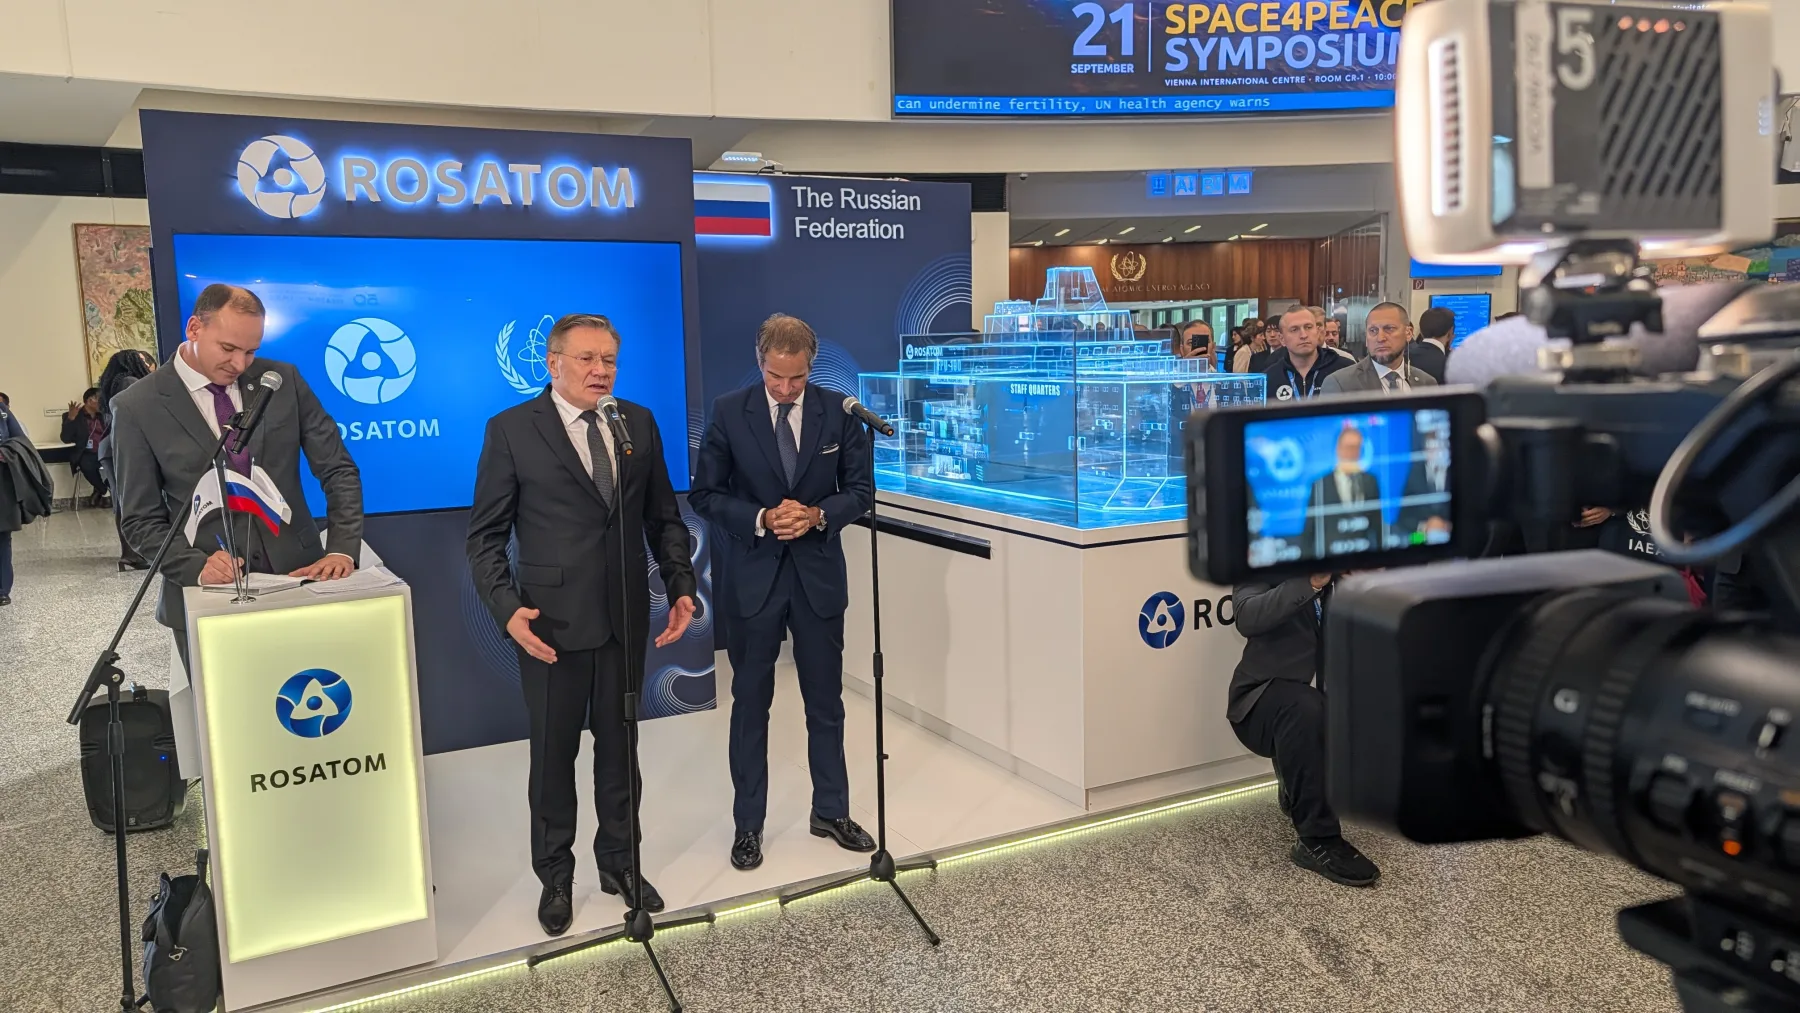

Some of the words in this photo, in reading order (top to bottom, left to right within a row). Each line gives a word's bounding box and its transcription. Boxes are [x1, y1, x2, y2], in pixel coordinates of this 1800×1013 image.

[1071, 2, 1134, 56] 21
[1557, 8, 1595, 90] 5
[1070, 63, 1135, 74] SEPTEMBER
[1164, 78, 1198, 87] VIENNA
[1200, 76, 1269, 86] INTERNATIONAL
[1272, 75, 1306, 85] CENTRE
[1315, 74, 1342, 83] ROOM
[1345, 73, 1364, 82] CR-1
[897, 99, 922, 109] can
[929, 98, 1001, 110] undermine
[1008, 98, 1087, 112] fertility,
[1095, 100, 1112, 109] UN
[1118, 98, 1167, 109] health
[1174, 99, 1223, 111] agency
[1229, 97, 1271, 108] warns
[342, 157, 635, 209] ROSATOM
[791, 186, 834, 208] The
[840, 187, 921, 211] Russian
[795, 216, 905, 240] Federation
[914, 346, 944, 357] ROSATOM
[1010, 383, 1027, 395] STAFF
[1028, 384, 1061, 396] QUARTERS
[337, 419, 440, 441] OSATOM
[250, 752, 387, 793] ROSATOM
